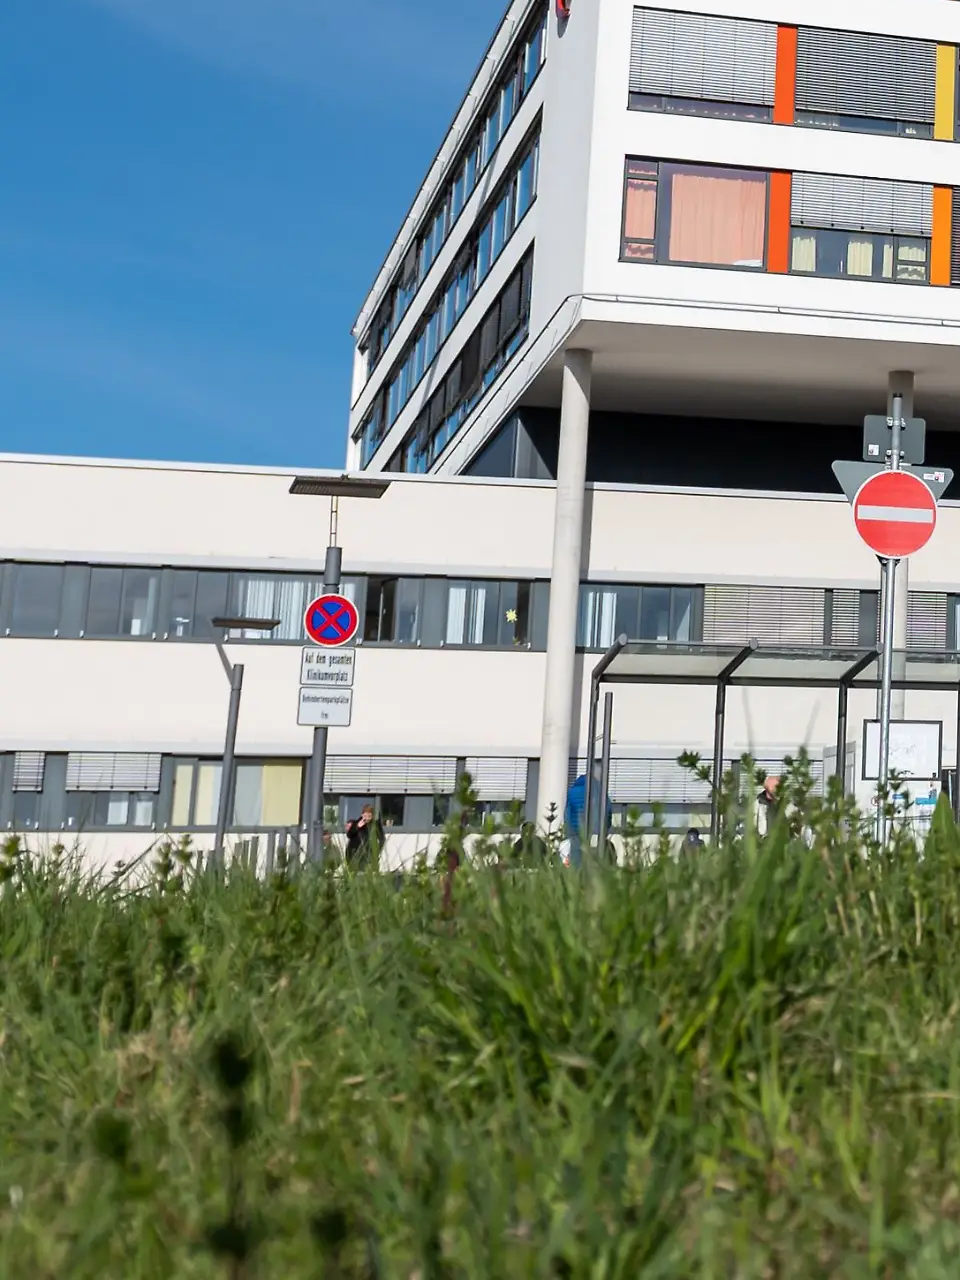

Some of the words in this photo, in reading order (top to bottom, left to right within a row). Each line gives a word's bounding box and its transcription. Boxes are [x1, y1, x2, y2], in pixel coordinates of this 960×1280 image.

[305, 652, 315, 663] Auf
[316, 652, 326, 664] dem
[329, 654, 352, 667] gesamten
